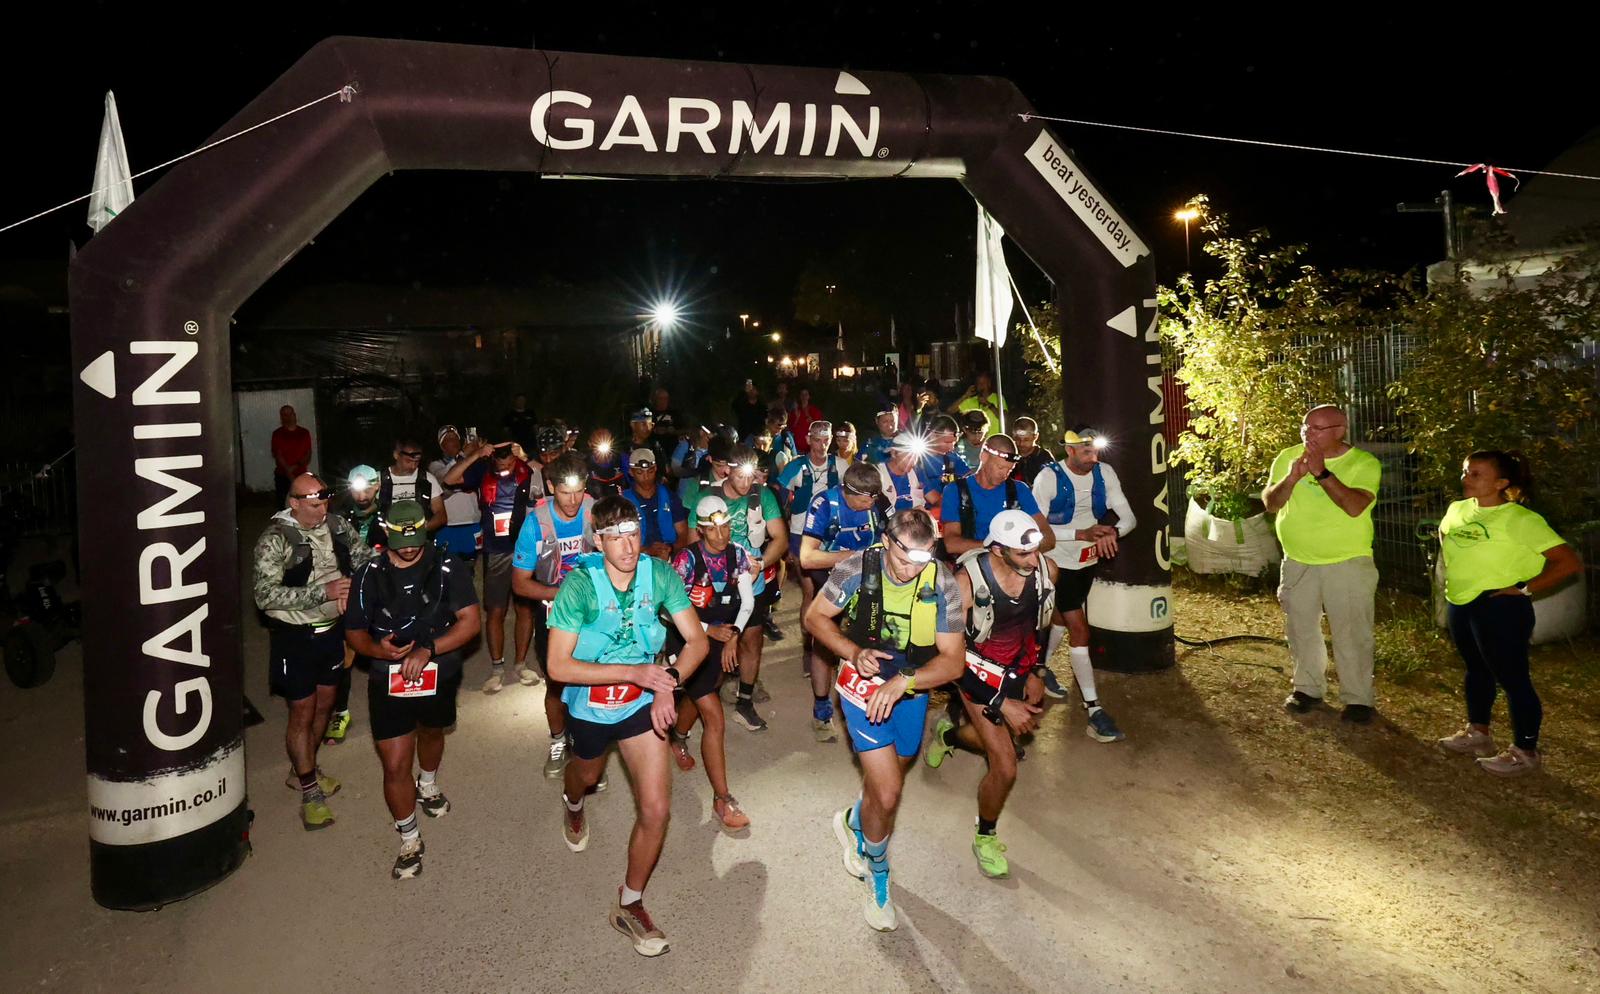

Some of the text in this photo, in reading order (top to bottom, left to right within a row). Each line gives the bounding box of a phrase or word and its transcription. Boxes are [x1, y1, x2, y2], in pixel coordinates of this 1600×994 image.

[1042, 144, 1131, 253] beat yesterday.
[605, 685, 629, 700] 17
[847, 673, 868, 695] 16
[90, 777, 227, 826] www.garmin.co.il
